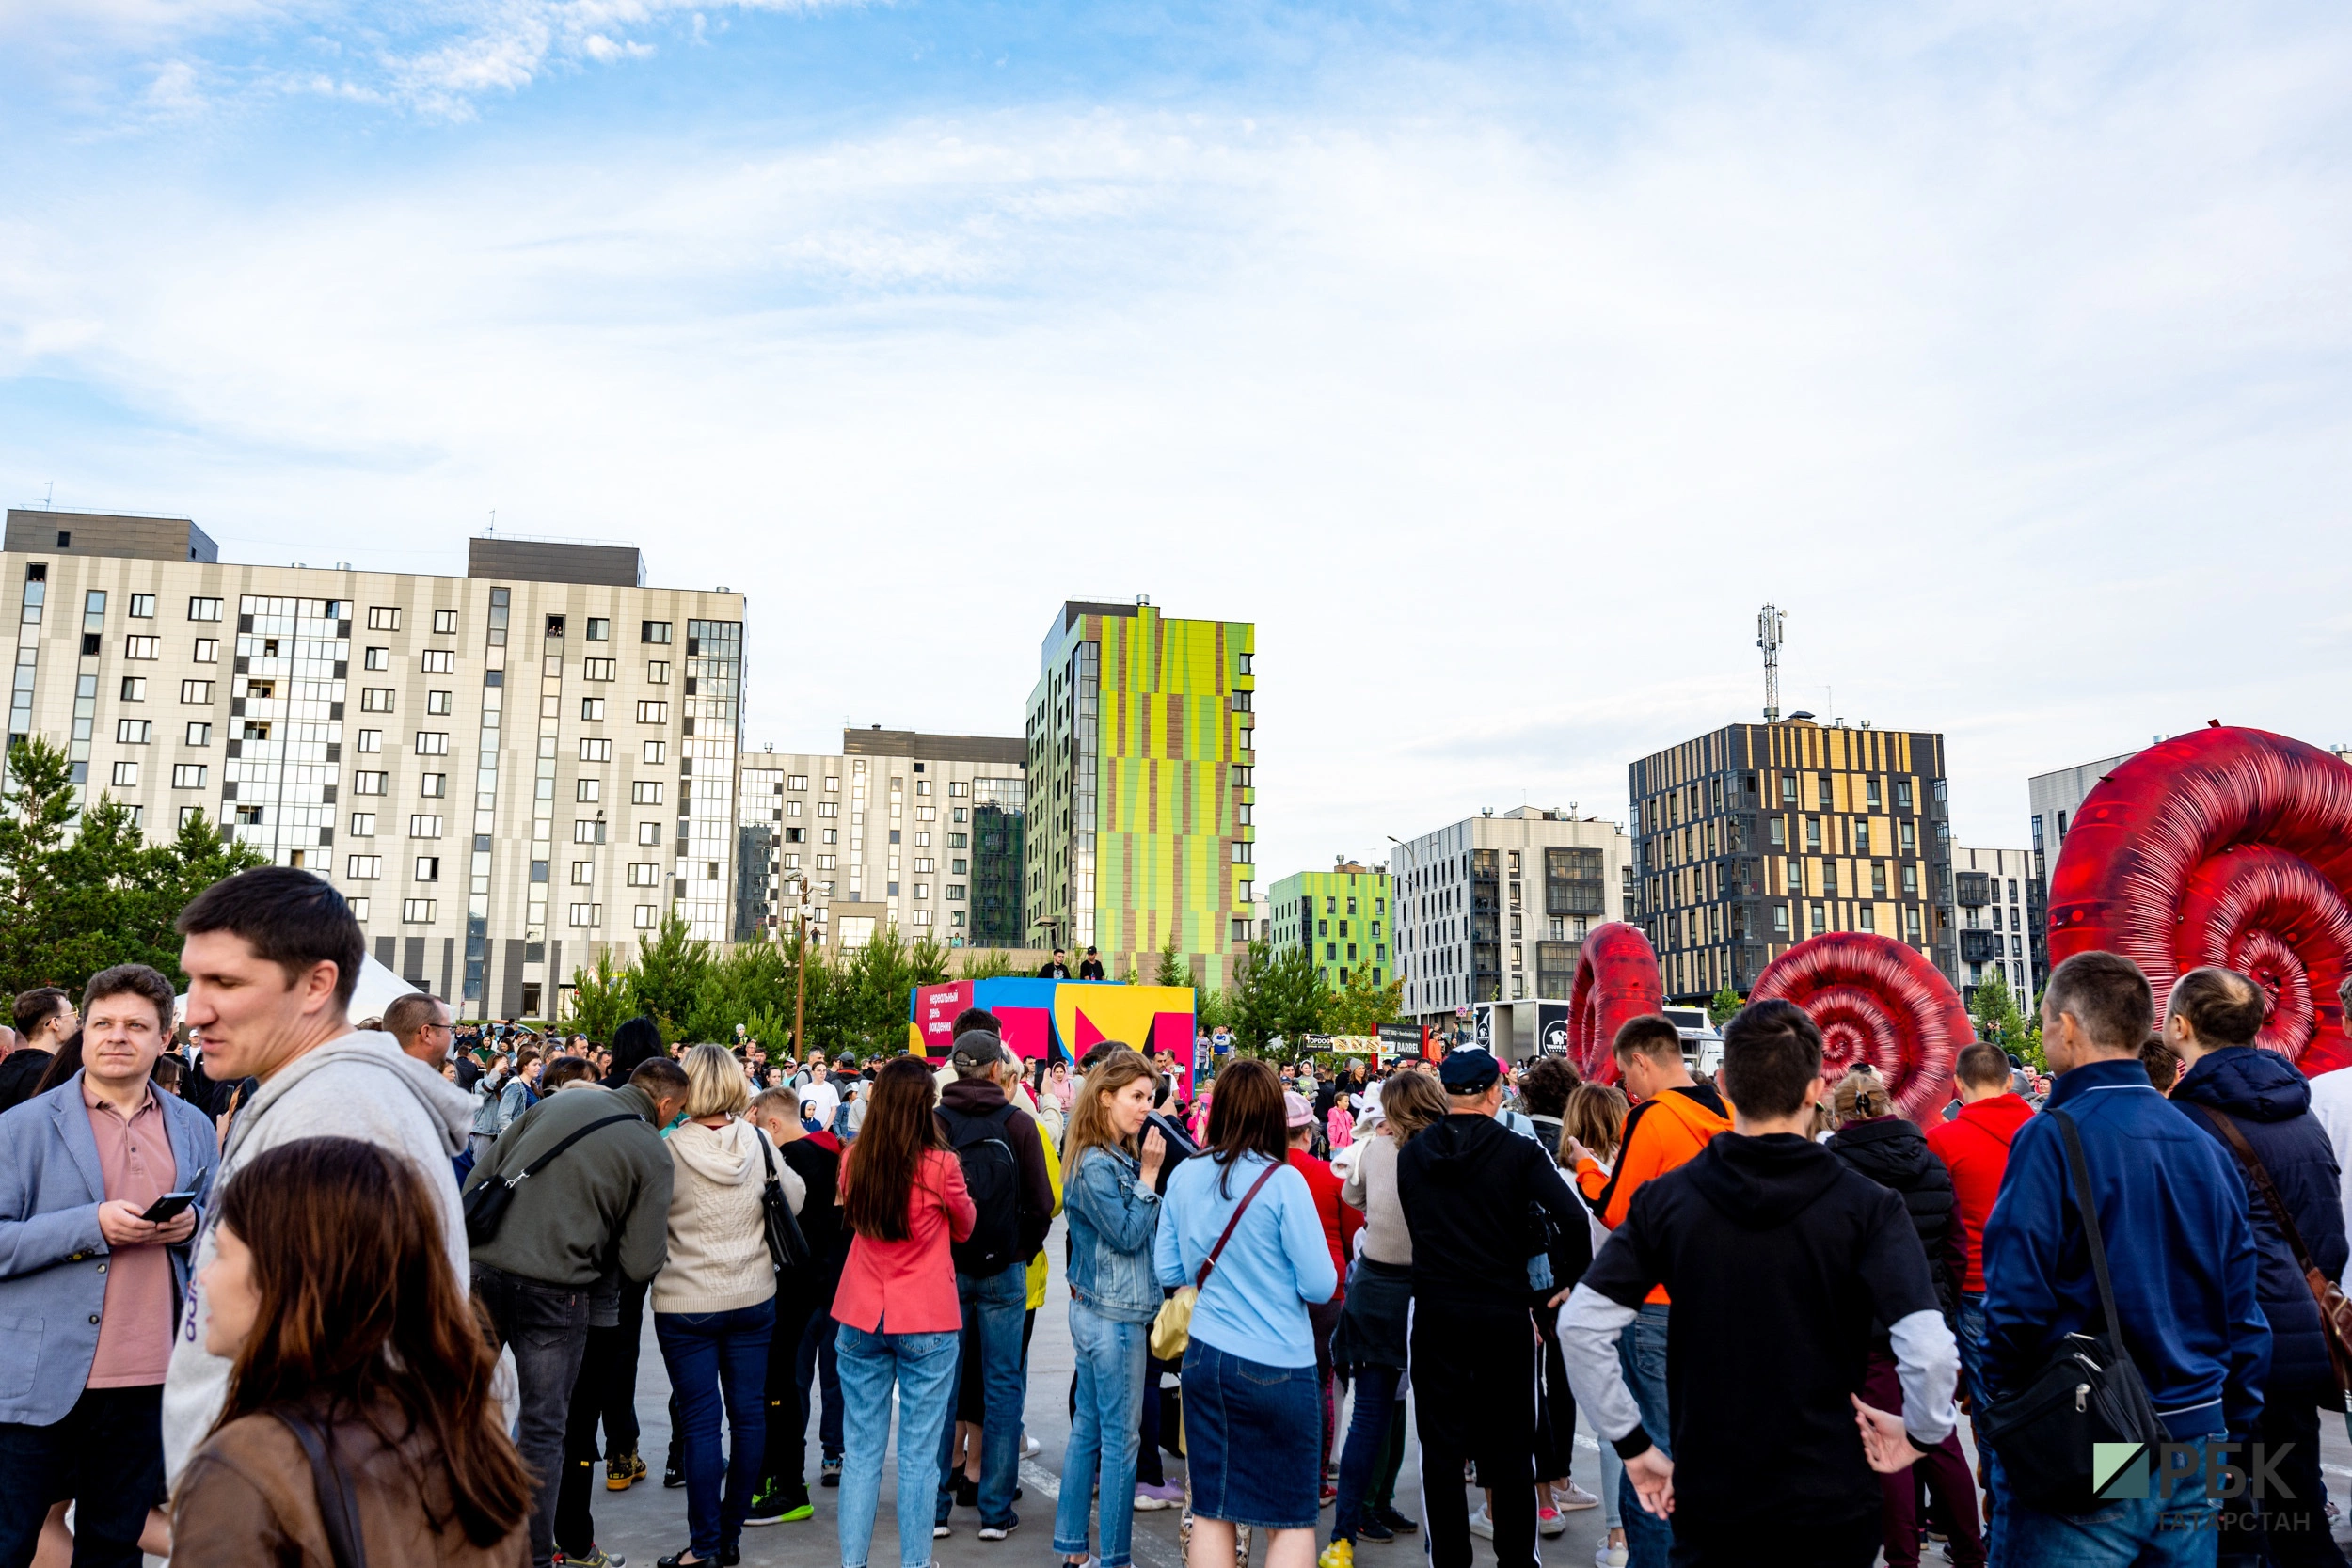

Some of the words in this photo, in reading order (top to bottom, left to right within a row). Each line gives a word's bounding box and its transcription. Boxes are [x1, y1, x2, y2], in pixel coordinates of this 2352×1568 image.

[930, 989, 958, 1006] нереальный
[929, 1008, 940, 1020] день
[929, 1022, 951, 1035] рождения
[1397, 1042, 1419, 1053] BARREL
